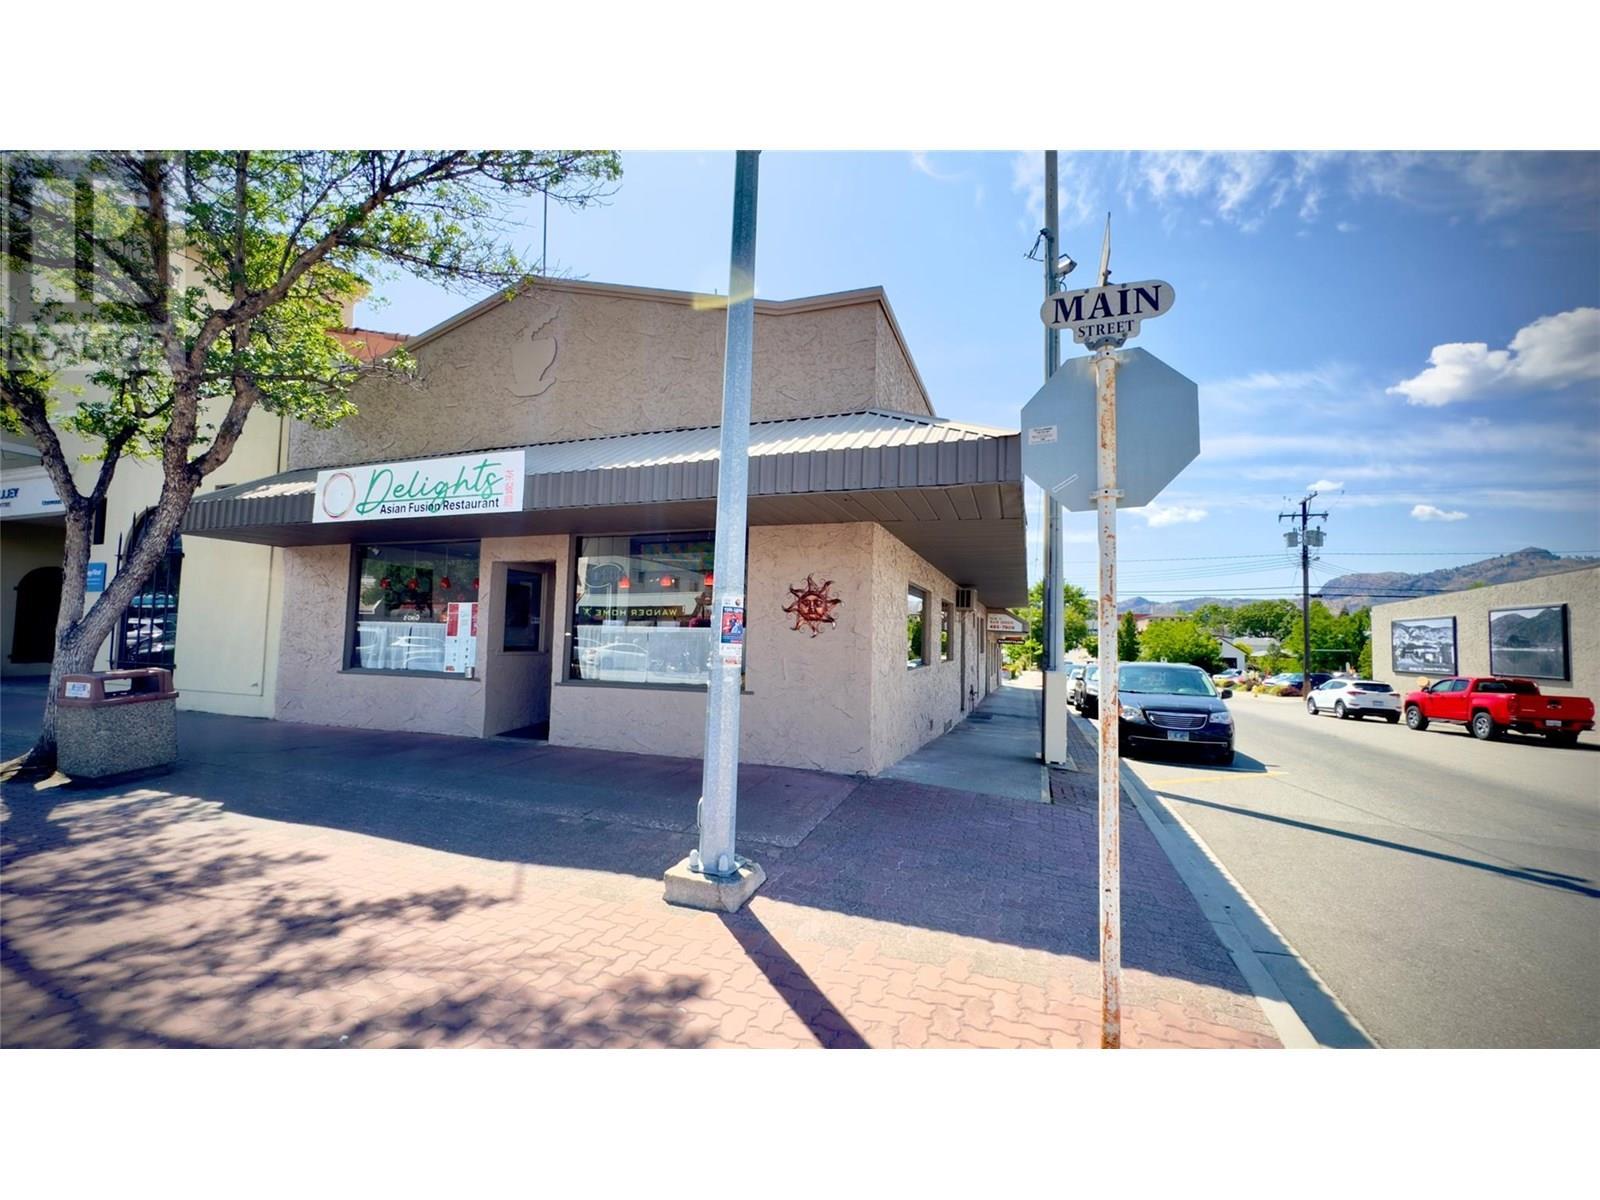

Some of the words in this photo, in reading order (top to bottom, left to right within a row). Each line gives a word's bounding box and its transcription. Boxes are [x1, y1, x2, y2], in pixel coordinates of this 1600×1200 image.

[1052, 284, 1162, 325] MAIN
[1078, 319, 1135, 338] STREET
[355, 458, 504, 516] Delights
[380, 503, 407, 514] Asian
[408, 501, 441, 513] Fusion
[443, 498, 500, 511] Restaurant
